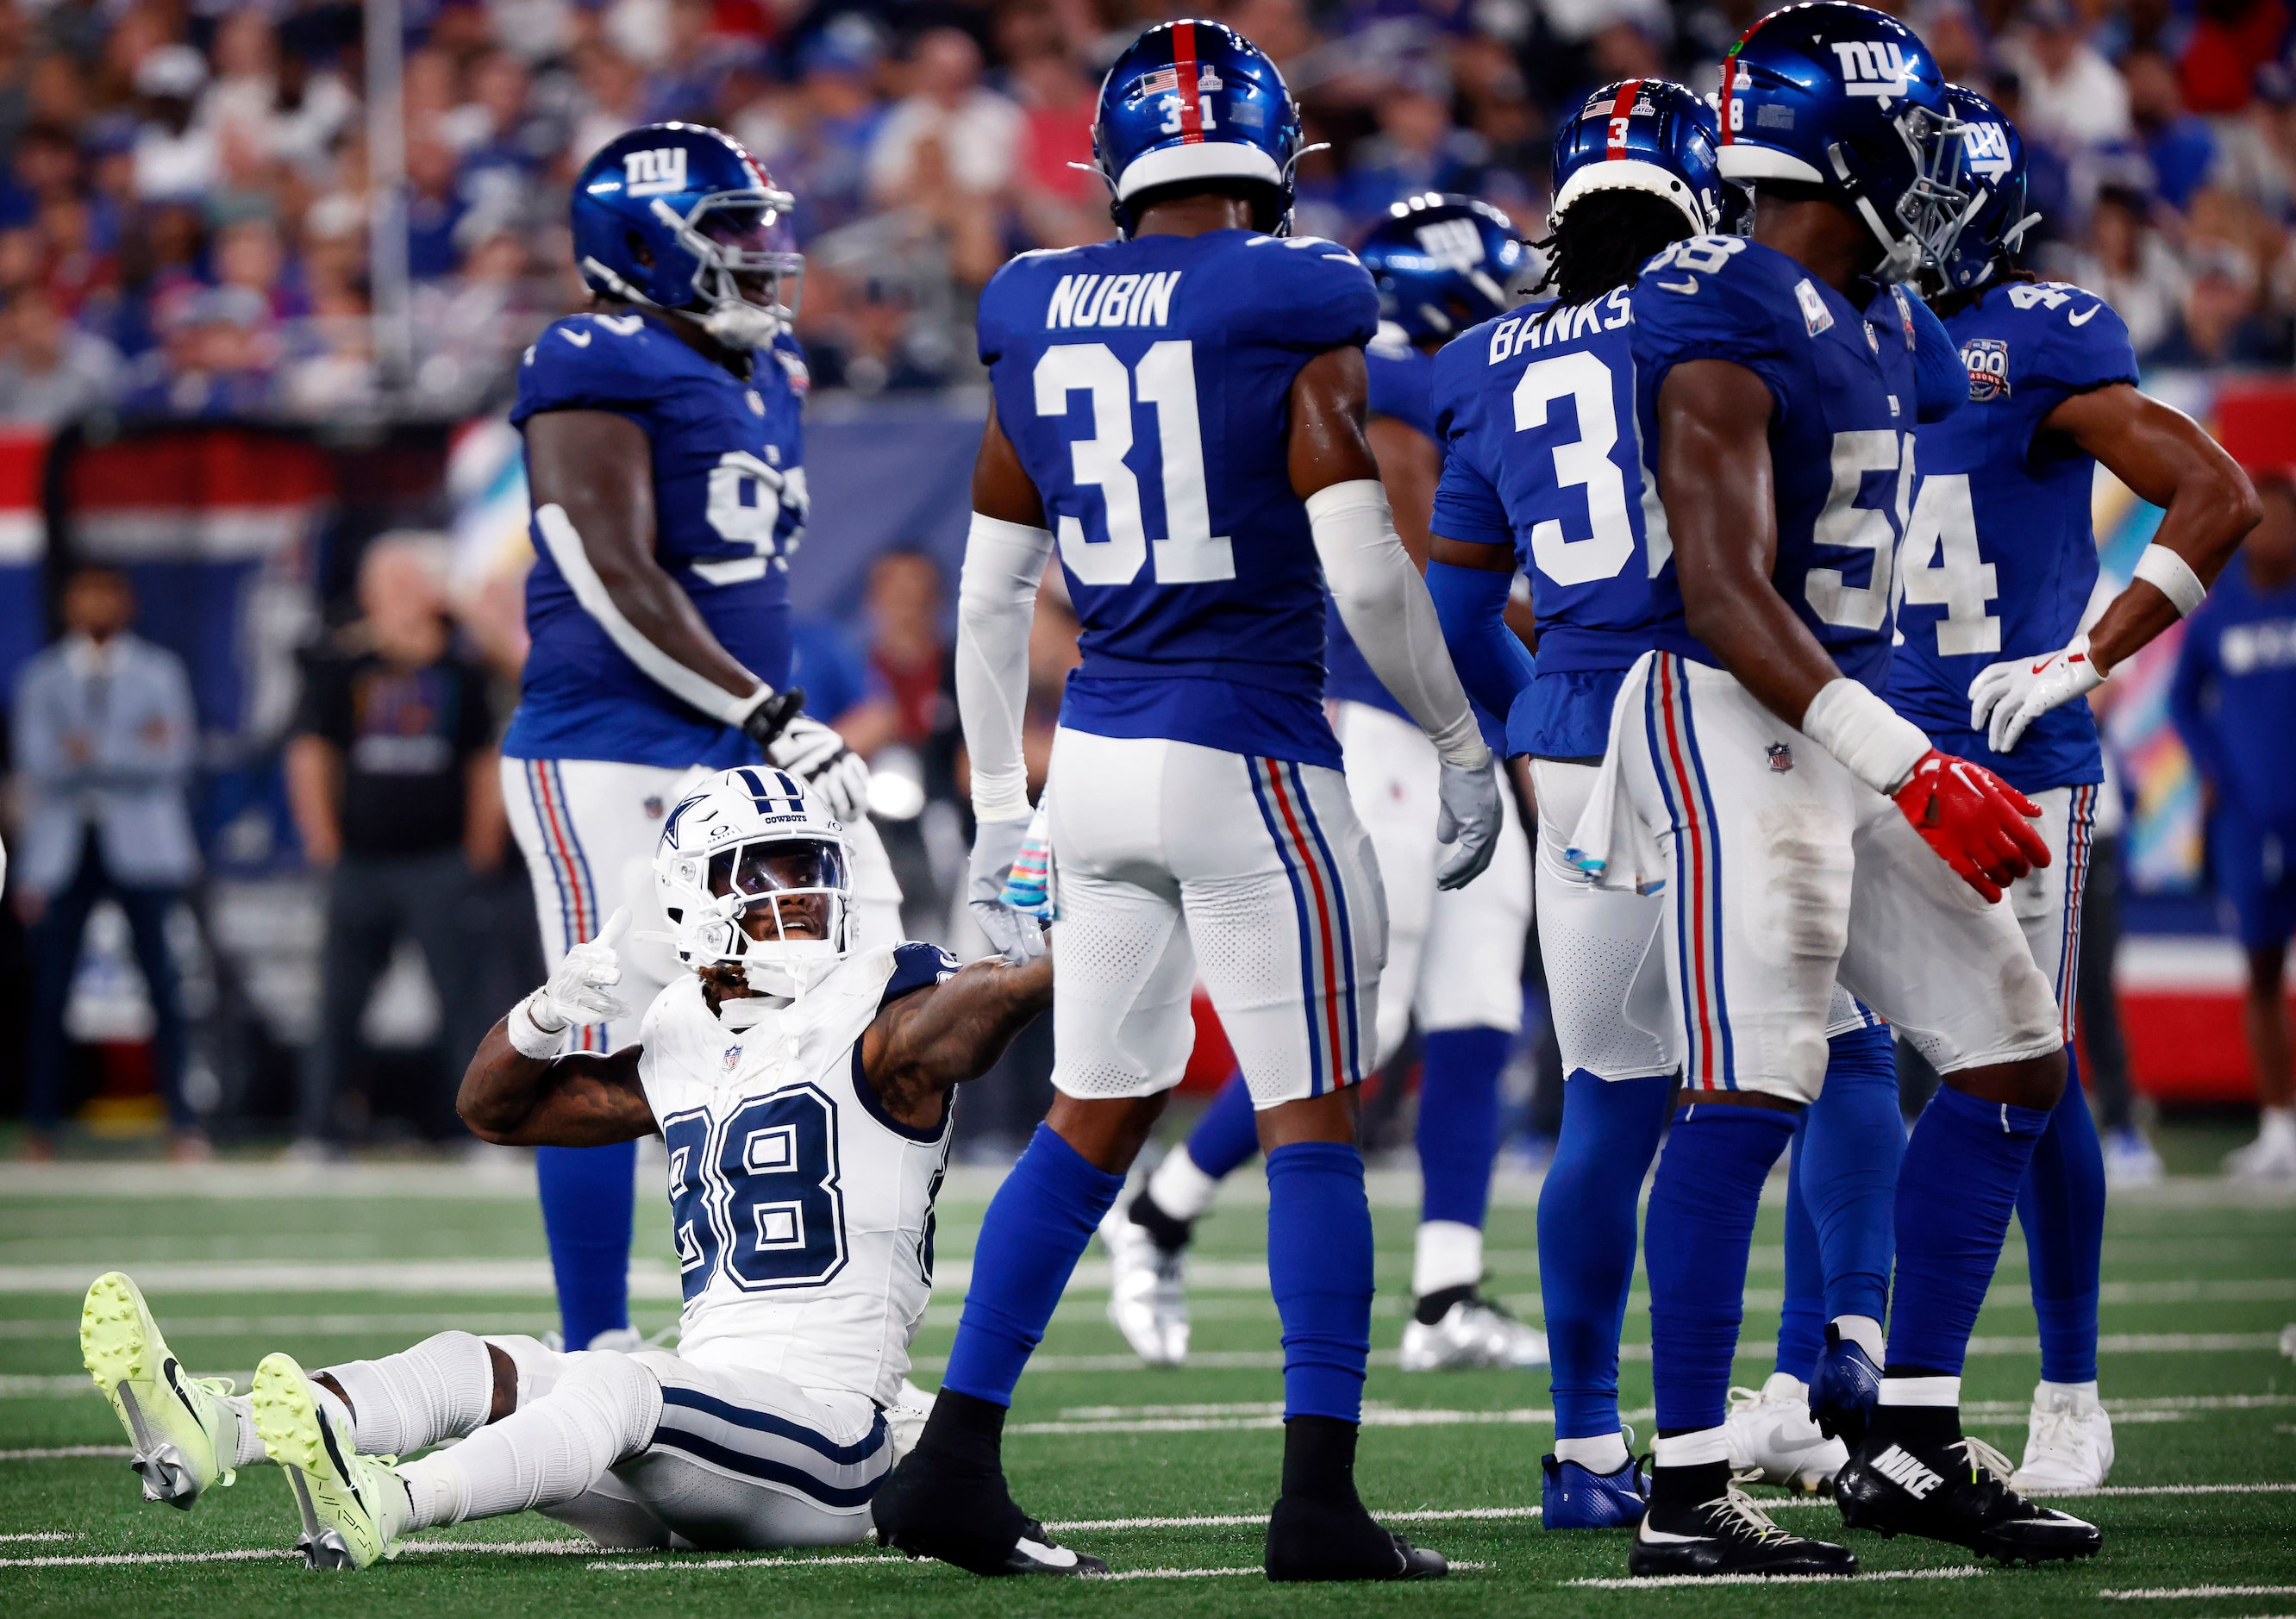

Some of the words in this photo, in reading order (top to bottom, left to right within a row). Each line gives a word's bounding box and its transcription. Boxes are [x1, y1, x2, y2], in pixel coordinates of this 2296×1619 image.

[1158, 94, 1217, 134] 31
[1607, 117, 1630, 147] 3
[1046, 271, 1182, 329] NUBIN
[1488, 284, 1632, 366] BANKS
[1033, 340, 1237, 585] 31
[1512, 350, 1636, 587] 3
[1805, 429, 1917, 647] 5
[766, 815, 808, 824] COWBOYS
[663, 1080, 849, 1313] 88
[1869, 1442, 1945, 1501] NIKE
